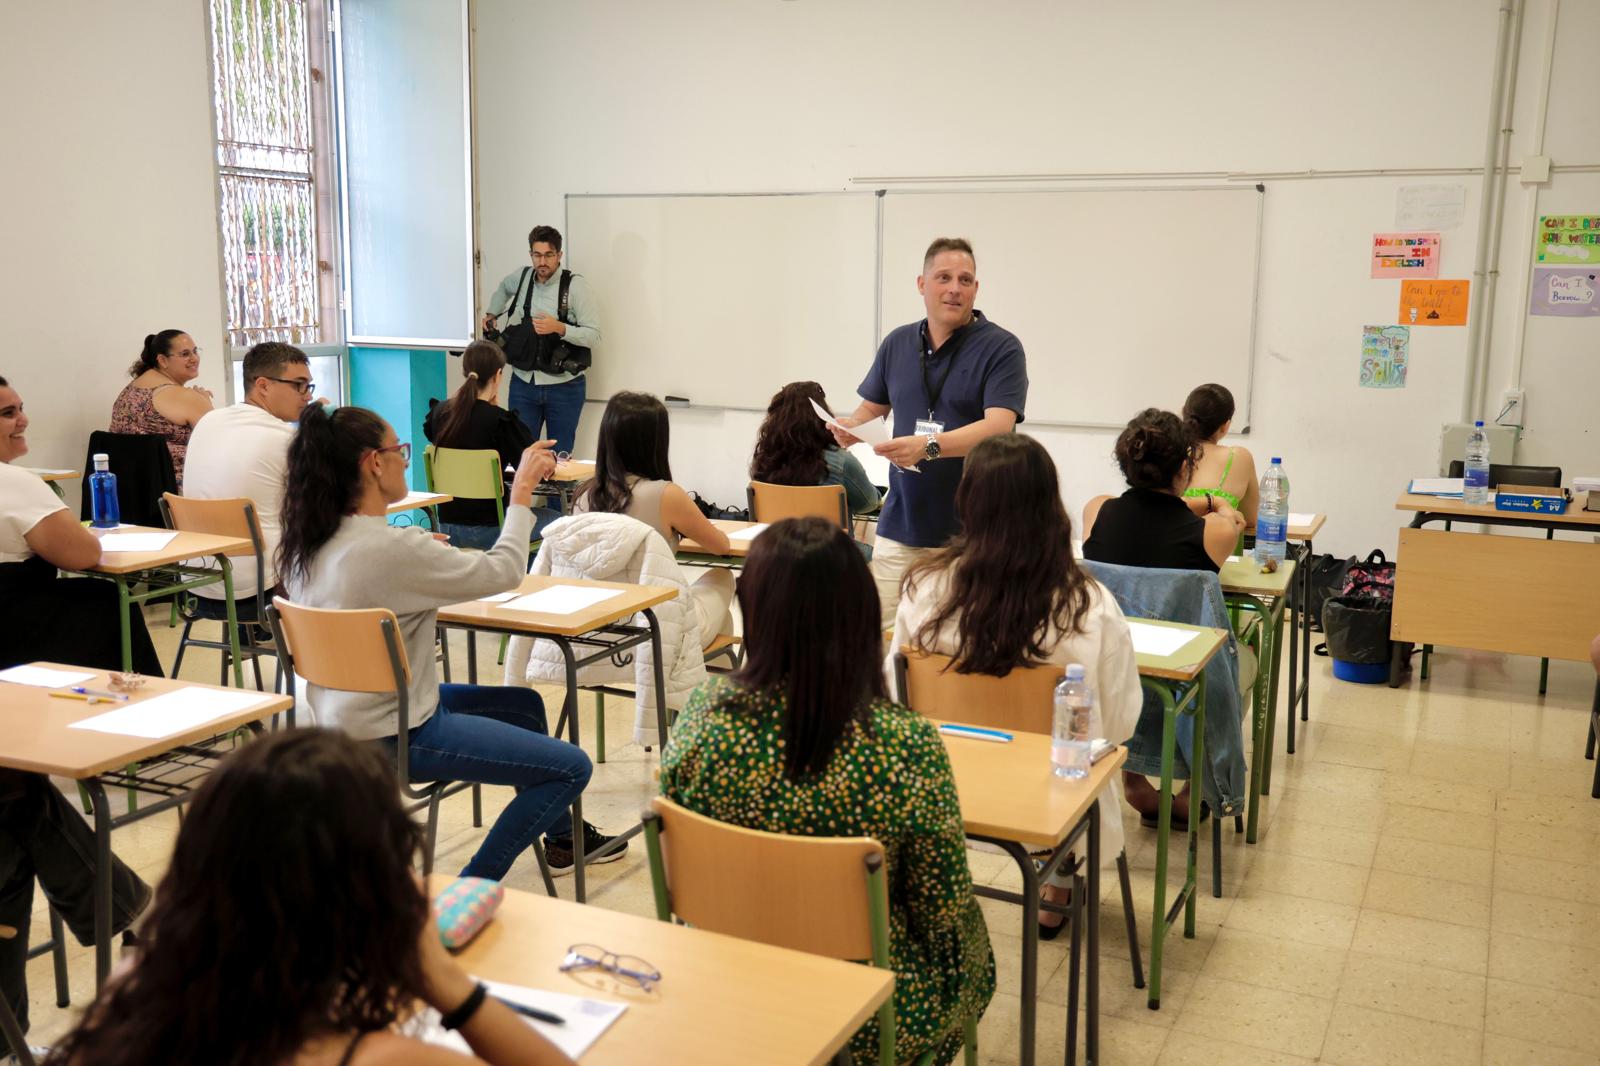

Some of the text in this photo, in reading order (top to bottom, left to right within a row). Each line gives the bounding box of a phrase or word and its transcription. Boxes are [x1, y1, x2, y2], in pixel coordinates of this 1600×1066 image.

[1545, 218, 1565, 229] CAN
[1569, 218, 1578, 229] I
[1411, 248, 1431, 257] IN
[1551, 277, 1583, 289] Can I
